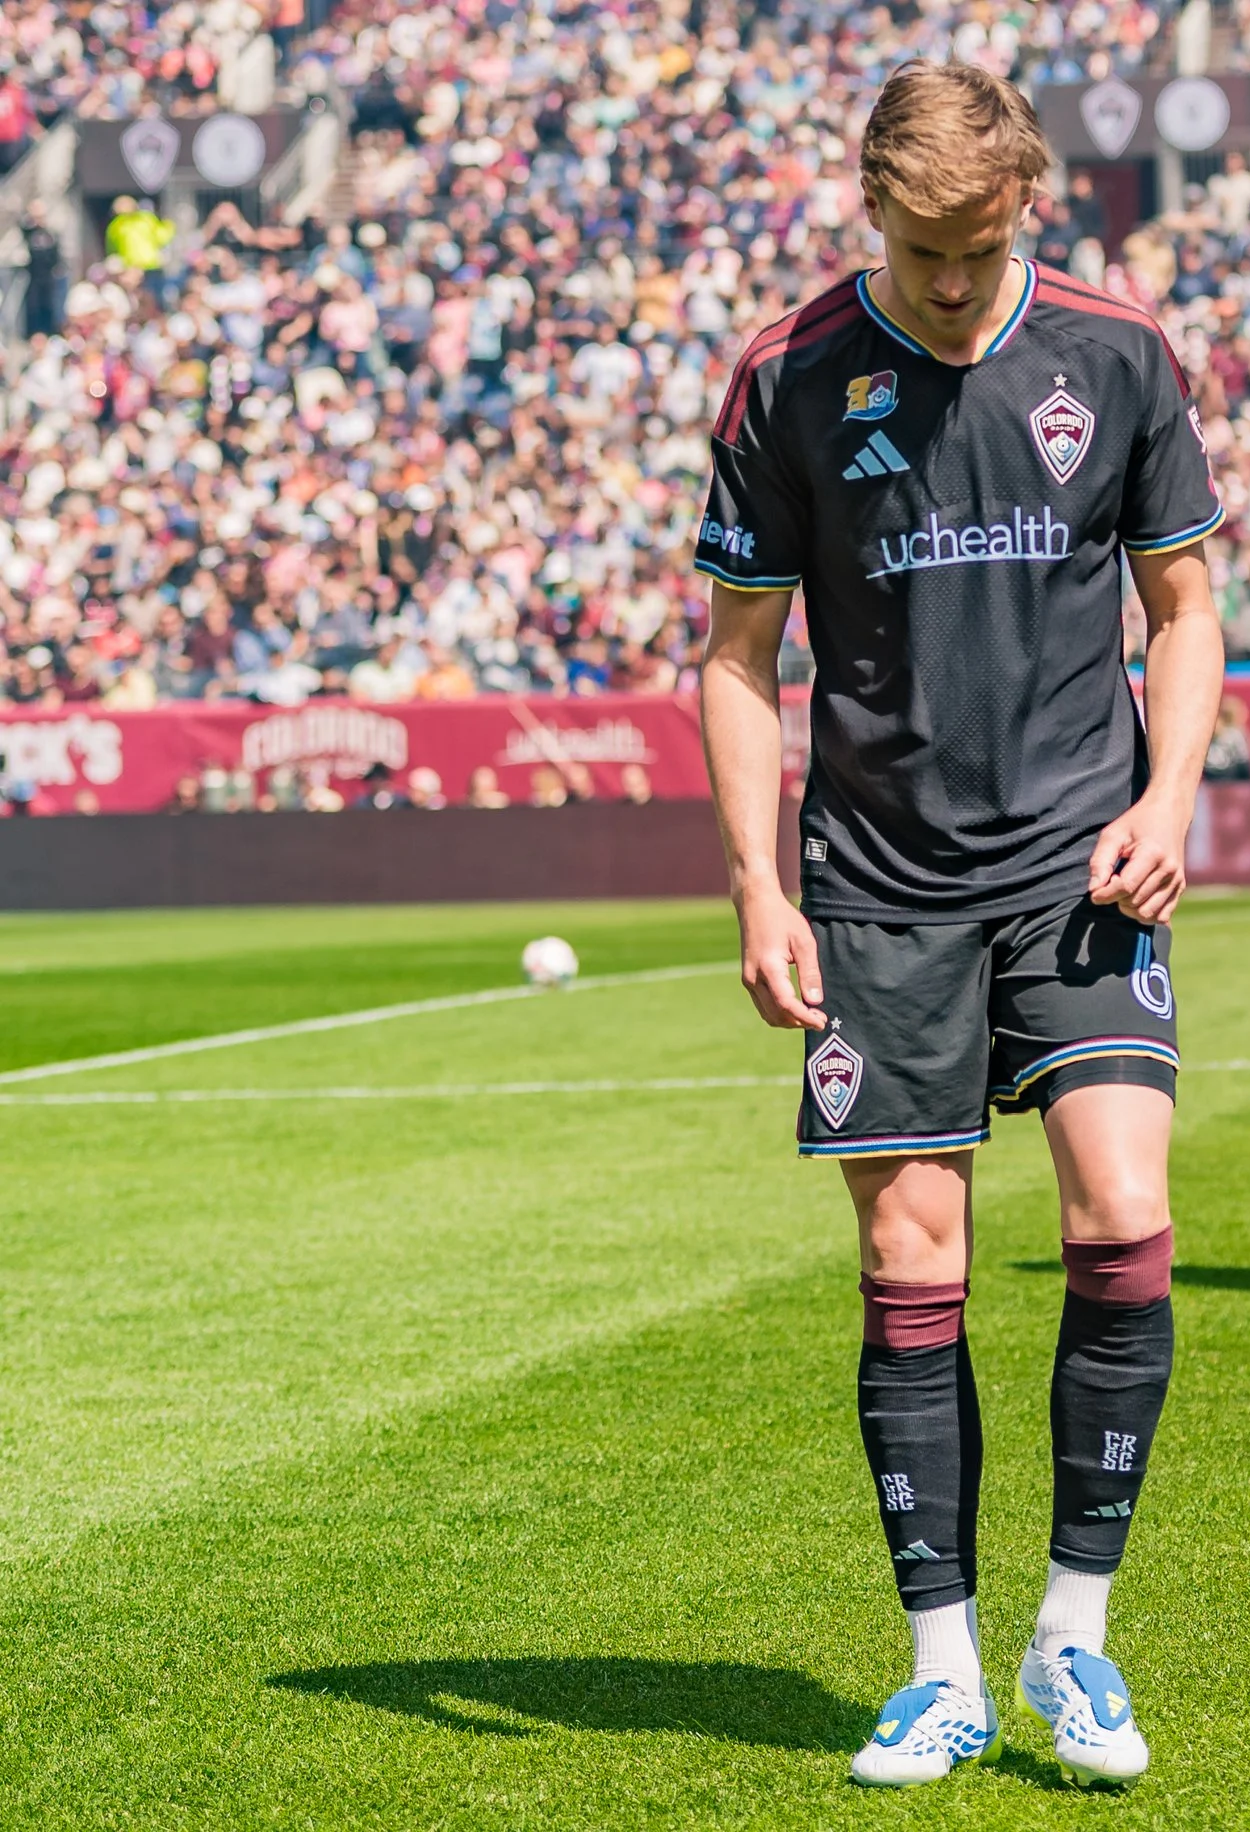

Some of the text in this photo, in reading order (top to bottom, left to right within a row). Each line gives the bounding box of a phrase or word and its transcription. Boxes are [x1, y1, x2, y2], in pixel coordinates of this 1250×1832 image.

[1042, 413, 1083, 429] COLORADO
[879, 505, 1071, 571] uchealth
[1131, 931, 1173, 1020] 6
[817, 1057, 853, 1075] COLORADO
